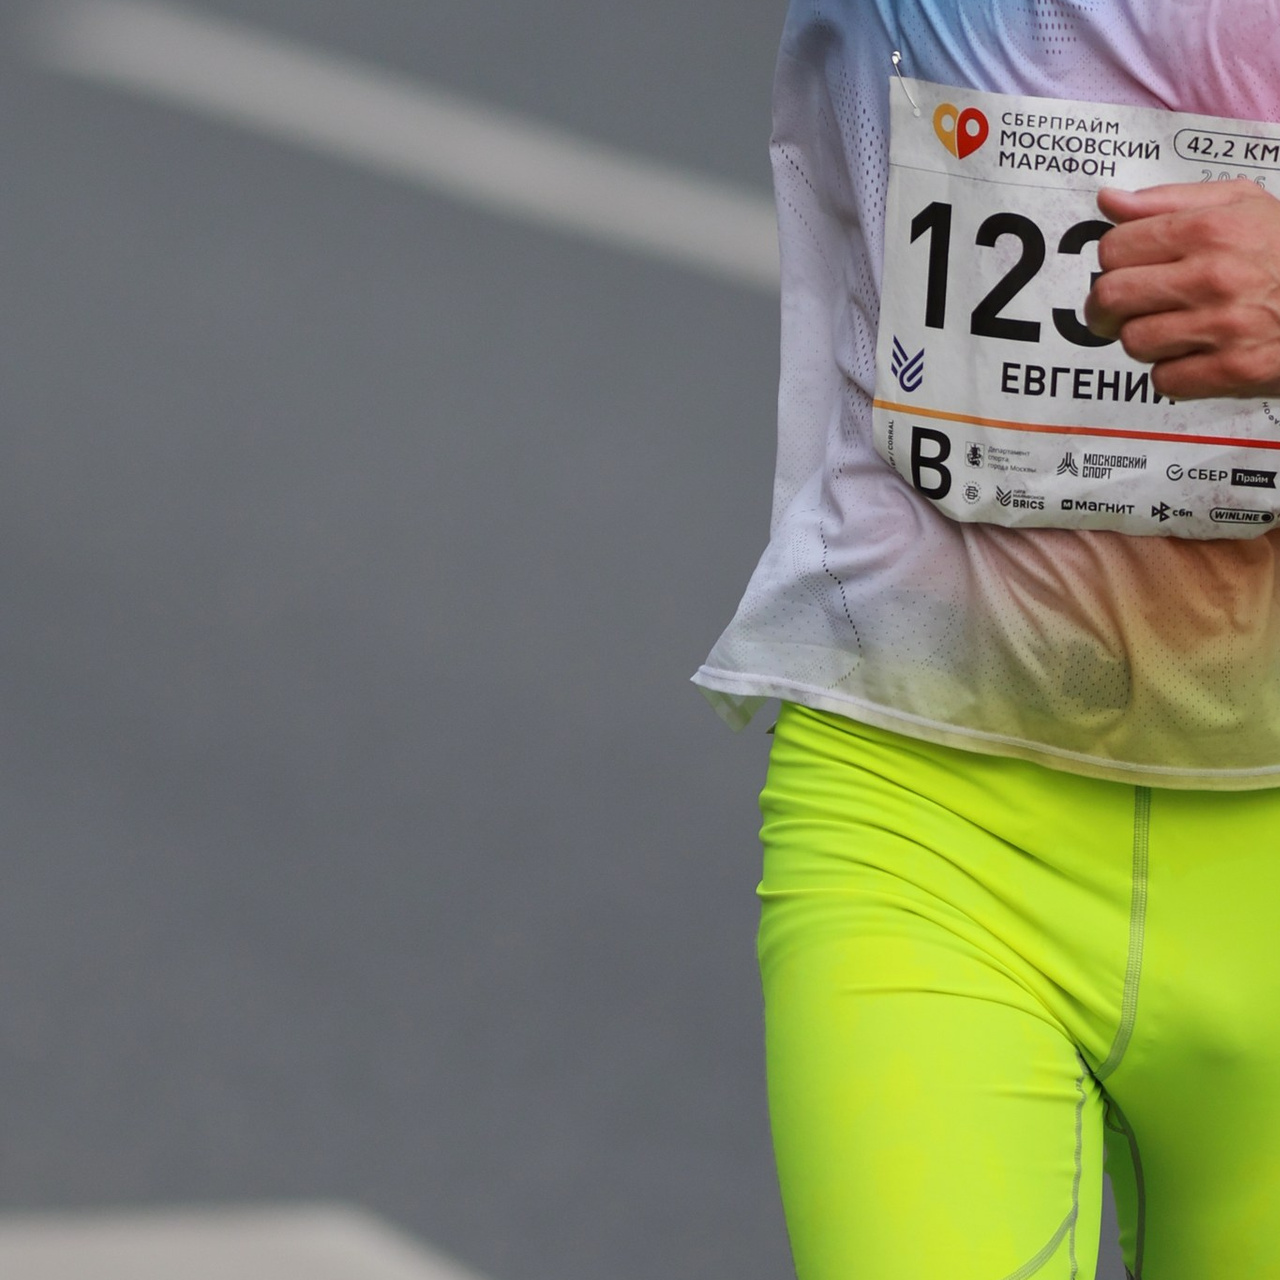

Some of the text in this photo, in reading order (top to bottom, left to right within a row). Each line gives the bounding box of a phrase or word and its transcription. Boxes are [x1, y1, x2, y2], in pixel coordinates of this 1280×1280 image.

[1001, 111, 1120, 135] СБЕРПРАЙМ
[1000, 129, 1161, 161] МОСКОВСКИЙ
[1186, 136, 1280, 163] 42,2 КМ
[998, 150, 1116, 178] МАРАФОН
[909, 201, 1120, 348] 123
[887, 419, 895, 451] CORRAL
[911, 425, 952, 501] B
[1082, 465, 1113, 480] СПОРТ
[1083, 452, 1147, 470] МОСКОВСКИЙ
[1187, 468, 1269, 484] СБЕР Прайм
[1013, 499, 1045, 510] BRICS
[1172, 508, 1193, 518] сбп
[1214, 511, 1260, 521] WINLINE
